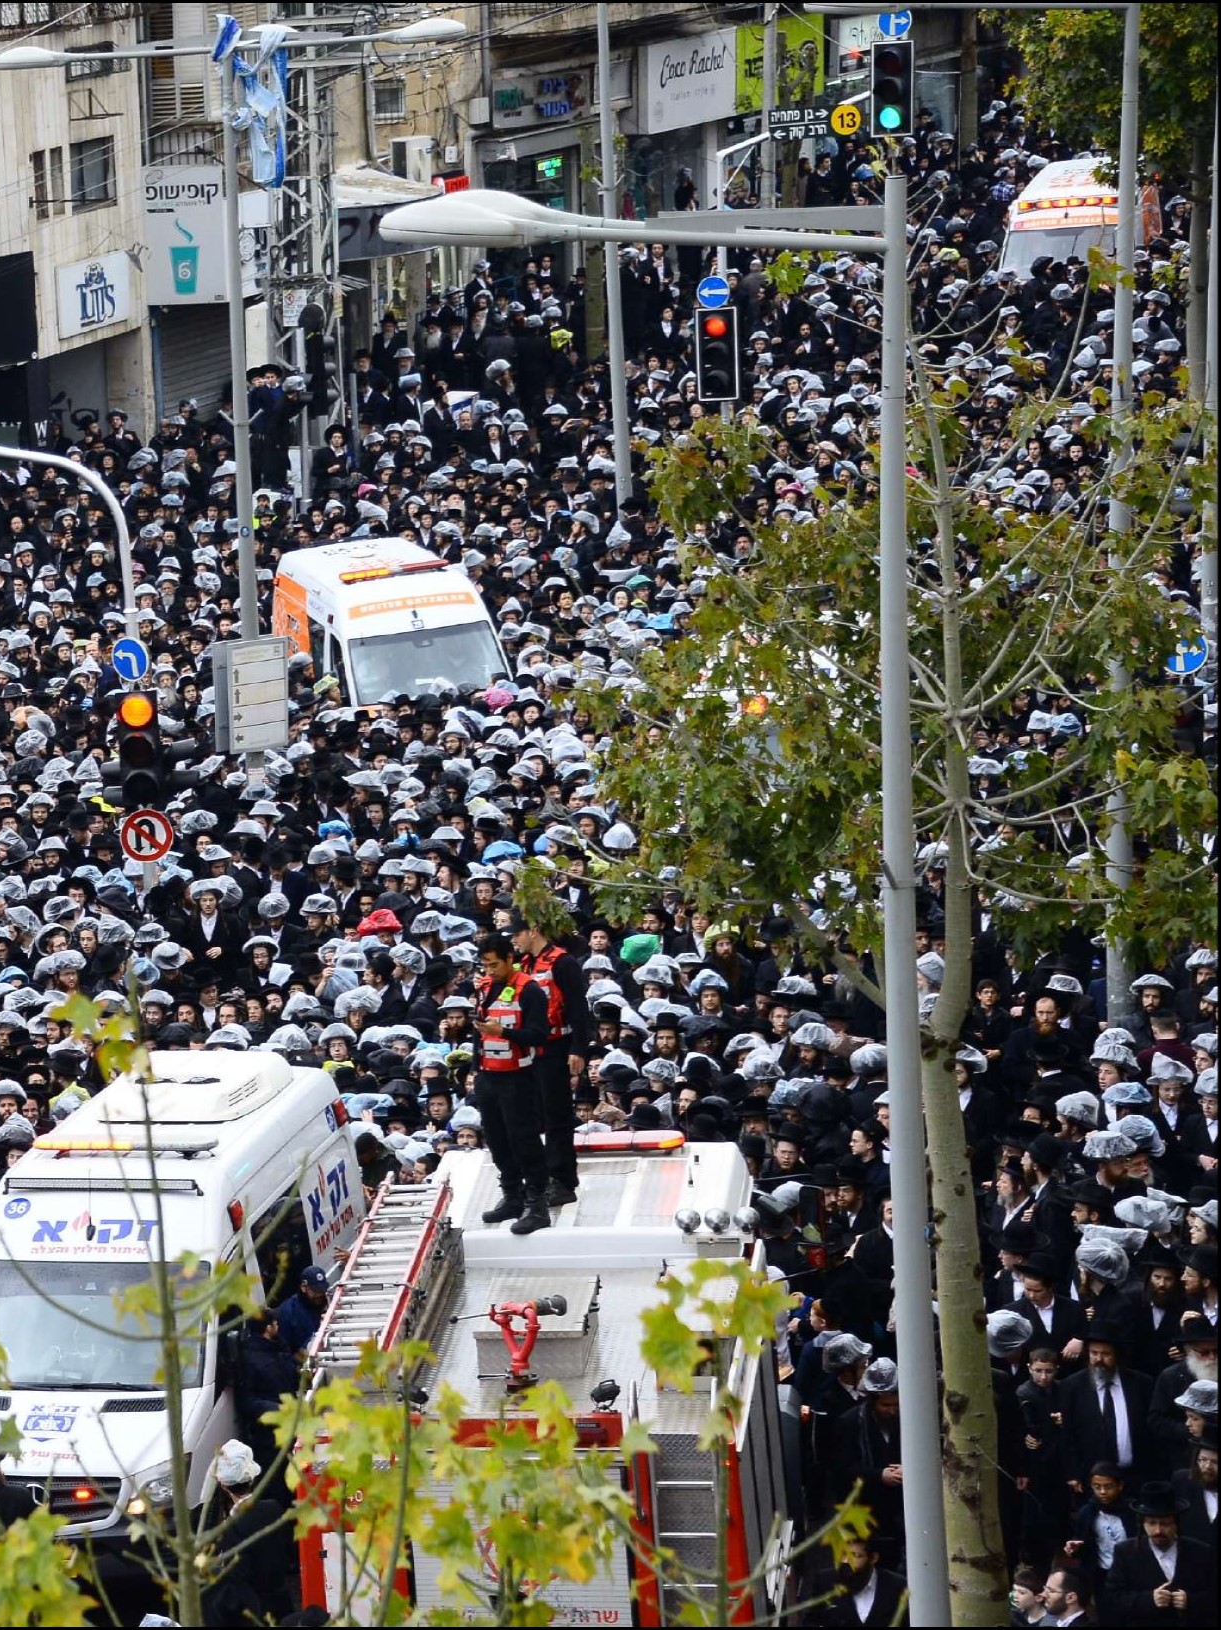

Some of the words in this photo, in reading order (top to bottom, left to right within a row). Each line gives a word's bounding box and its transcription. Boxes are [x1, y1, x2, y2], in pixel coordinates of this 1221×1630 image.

[660, 54, 686, 89] Coco
[689, 45, 726, 75] Rachel
[771, 110, 800, 122] פתחיה
[804, 109, 814, 123] בן
[837, 111, 857, 129] 13
[789, 126, 805, 140] קוק
[808, 124, 827, 136] הרב
[145, 183, 219, 204] קופישופ
[178, 260, 191, 279] 6
[34, 420, 48, 440] W
[8, 1201, 27, 1214] 36
